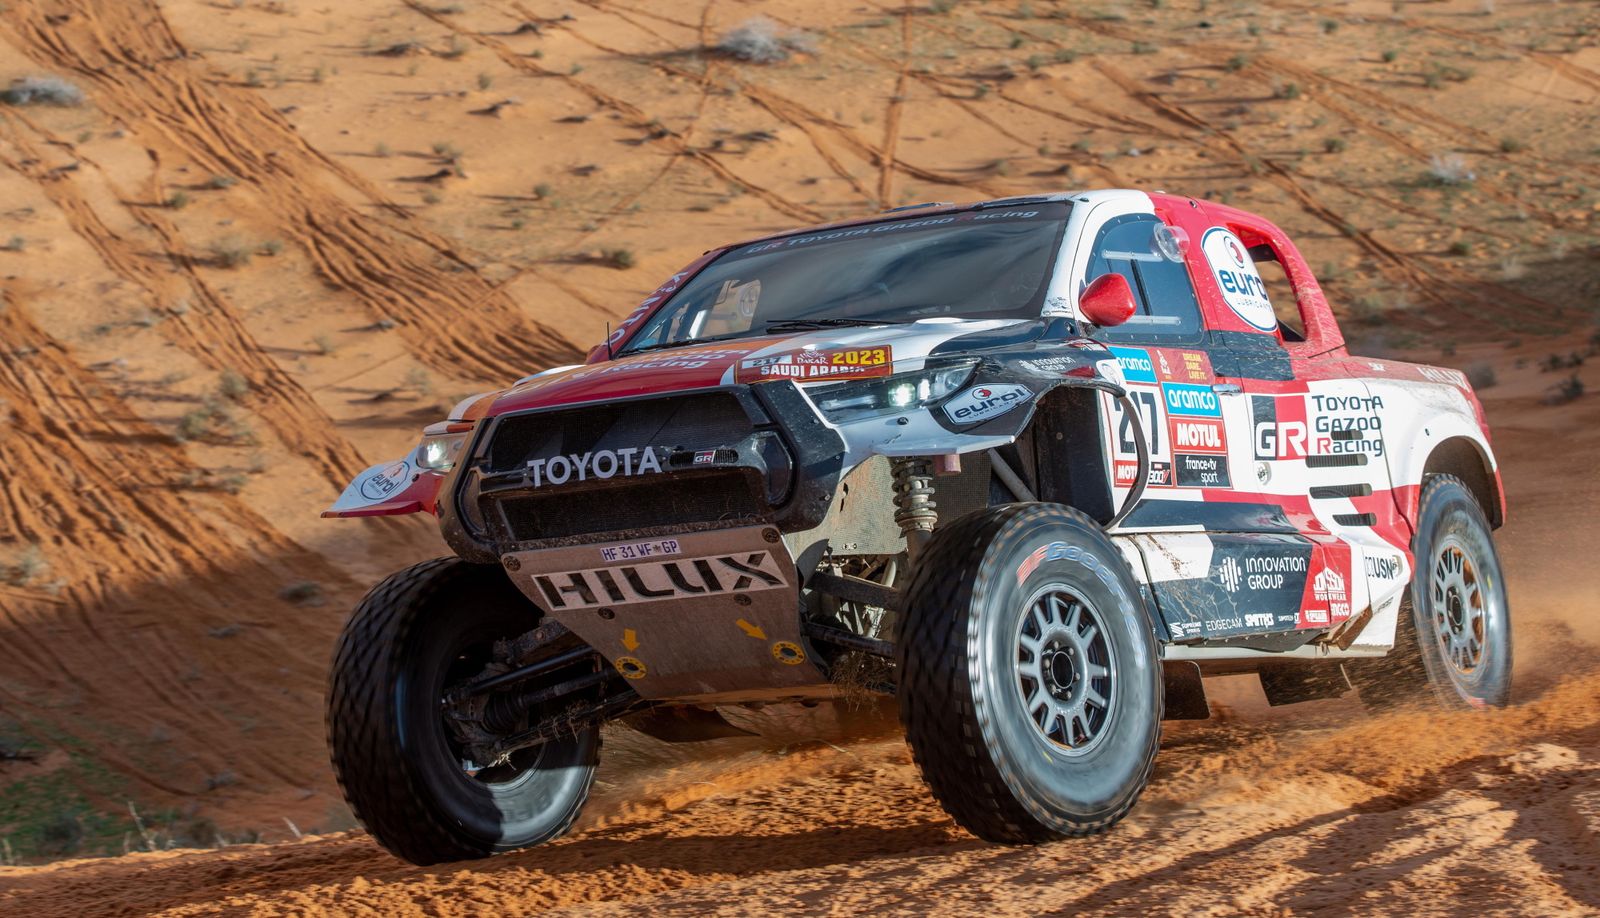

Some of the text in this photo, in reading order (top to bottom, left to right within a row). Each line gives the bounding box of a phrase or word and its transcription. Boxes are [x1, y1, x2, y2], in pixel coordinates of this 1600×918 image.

[797, 356, 828, 365] DAKAR
[832, 349, 886, 365] 2023
[761, 364, 805, 377] SAUDI
[954, 388, 1026, 418] eurol
[1168, 389, 1215, 410] aramco
[1255, 395, 1384, 457] GR TOYOTA
[1315, 416, 1381, 433] GAZOO
[1177, 423, 1221, 447] MOTUL
[1317, 437, 1384, 457] Racing
[527, 446, 713, 487] TOYOTA GR
[1200, 472, 1219, 486] sport
[602, 548, 618, 561] HF
[620, 546, 636, 559] 31
[661, 540, 678, 553] GP
[534, 552, 787, 609] HILUX
[1248, 574, 1284, 590] GROUP
[1315, 593, 1347, 601] WORKWEAR
[1205, 618, 1243, 632] EDGECAM
[1244, 612, 1275, 628] SMITHS
